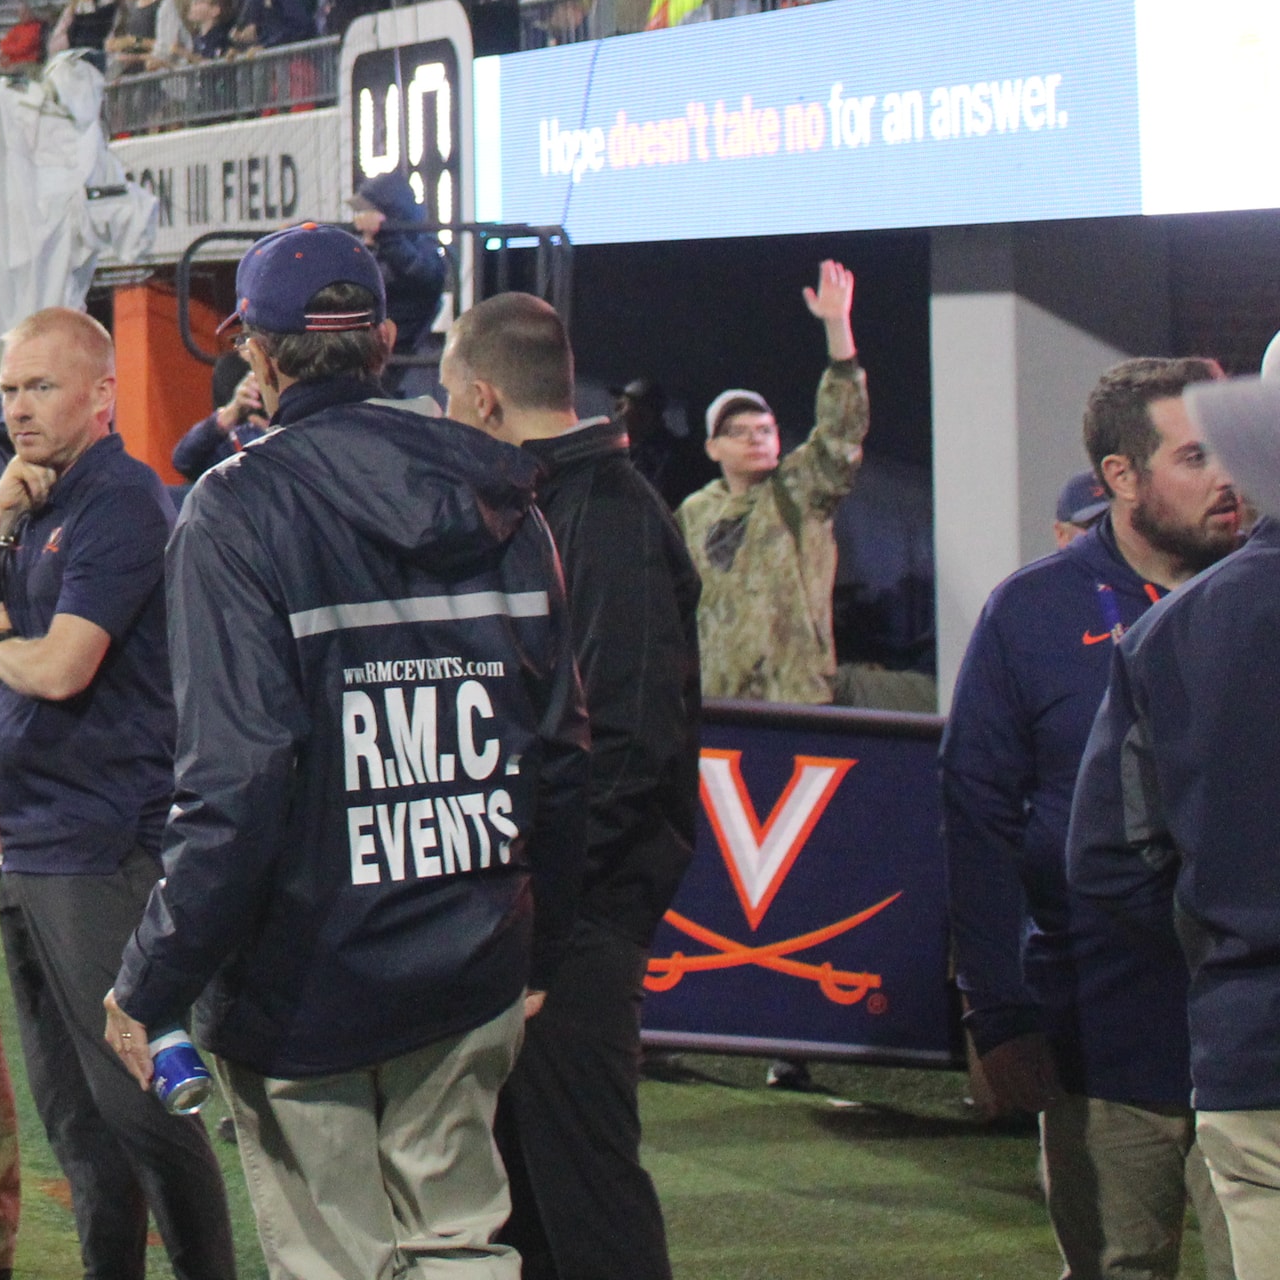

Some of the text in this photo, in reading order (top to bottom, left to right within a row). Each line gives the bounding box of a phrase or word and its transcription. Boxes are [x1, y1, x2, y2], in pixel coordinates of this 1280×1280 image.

[539, 72, 1069, 183] Hope doesn't take no for an answer.
[222, 153, 299, 223] FIELD
[346, 788, 520, 886] EVENTS
